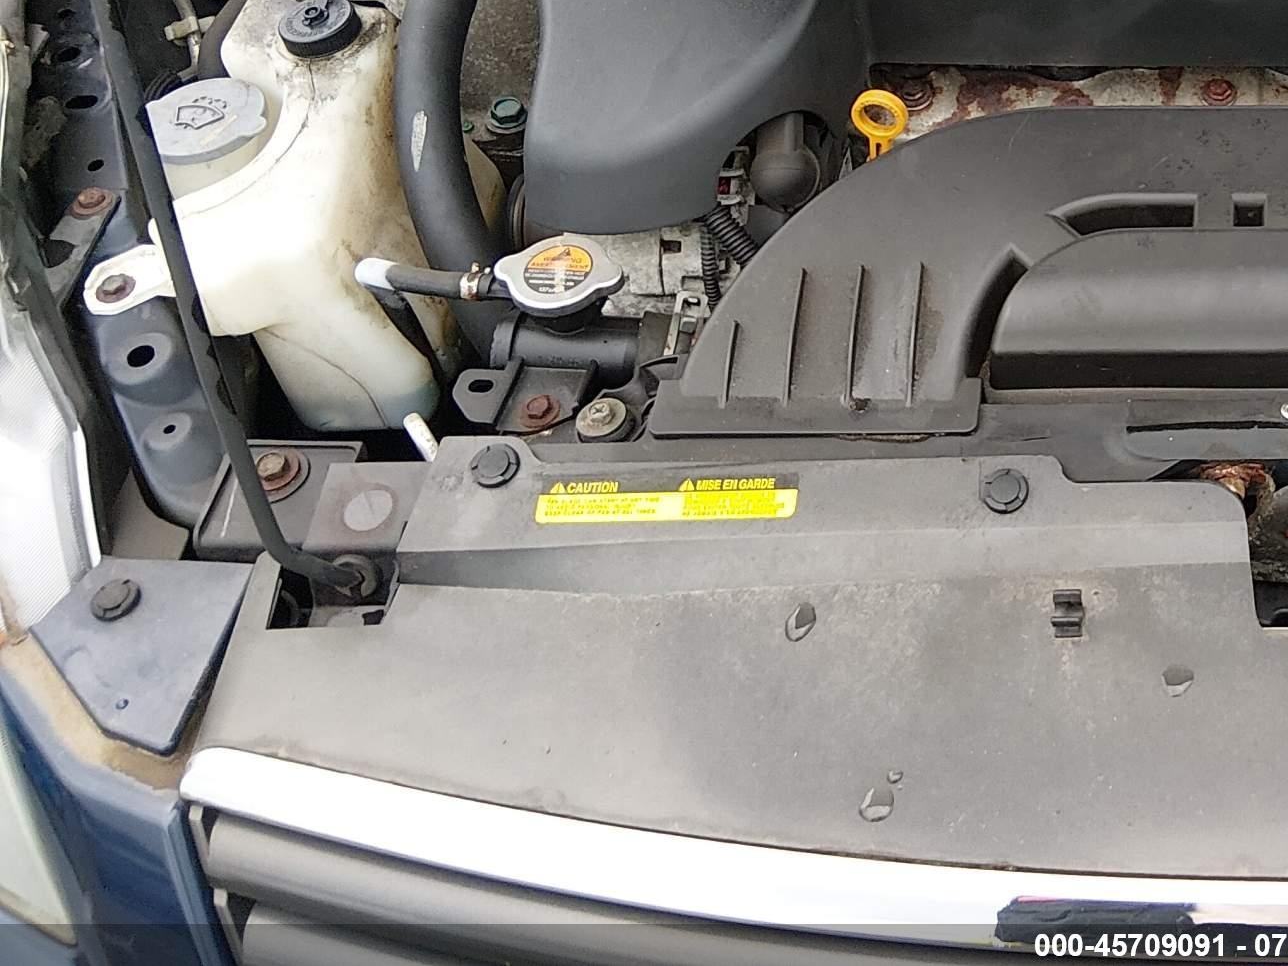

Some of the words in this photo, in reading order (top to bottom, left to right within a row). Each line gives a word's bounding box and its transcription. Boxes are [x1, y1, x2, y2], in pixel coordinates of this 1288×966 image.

[566, 481, 619, 494] CAUTION
[695, 478, 722, 491] MISE
[722, 478, 739, 491] EN
[739, 477, 776, 490] GARDE
